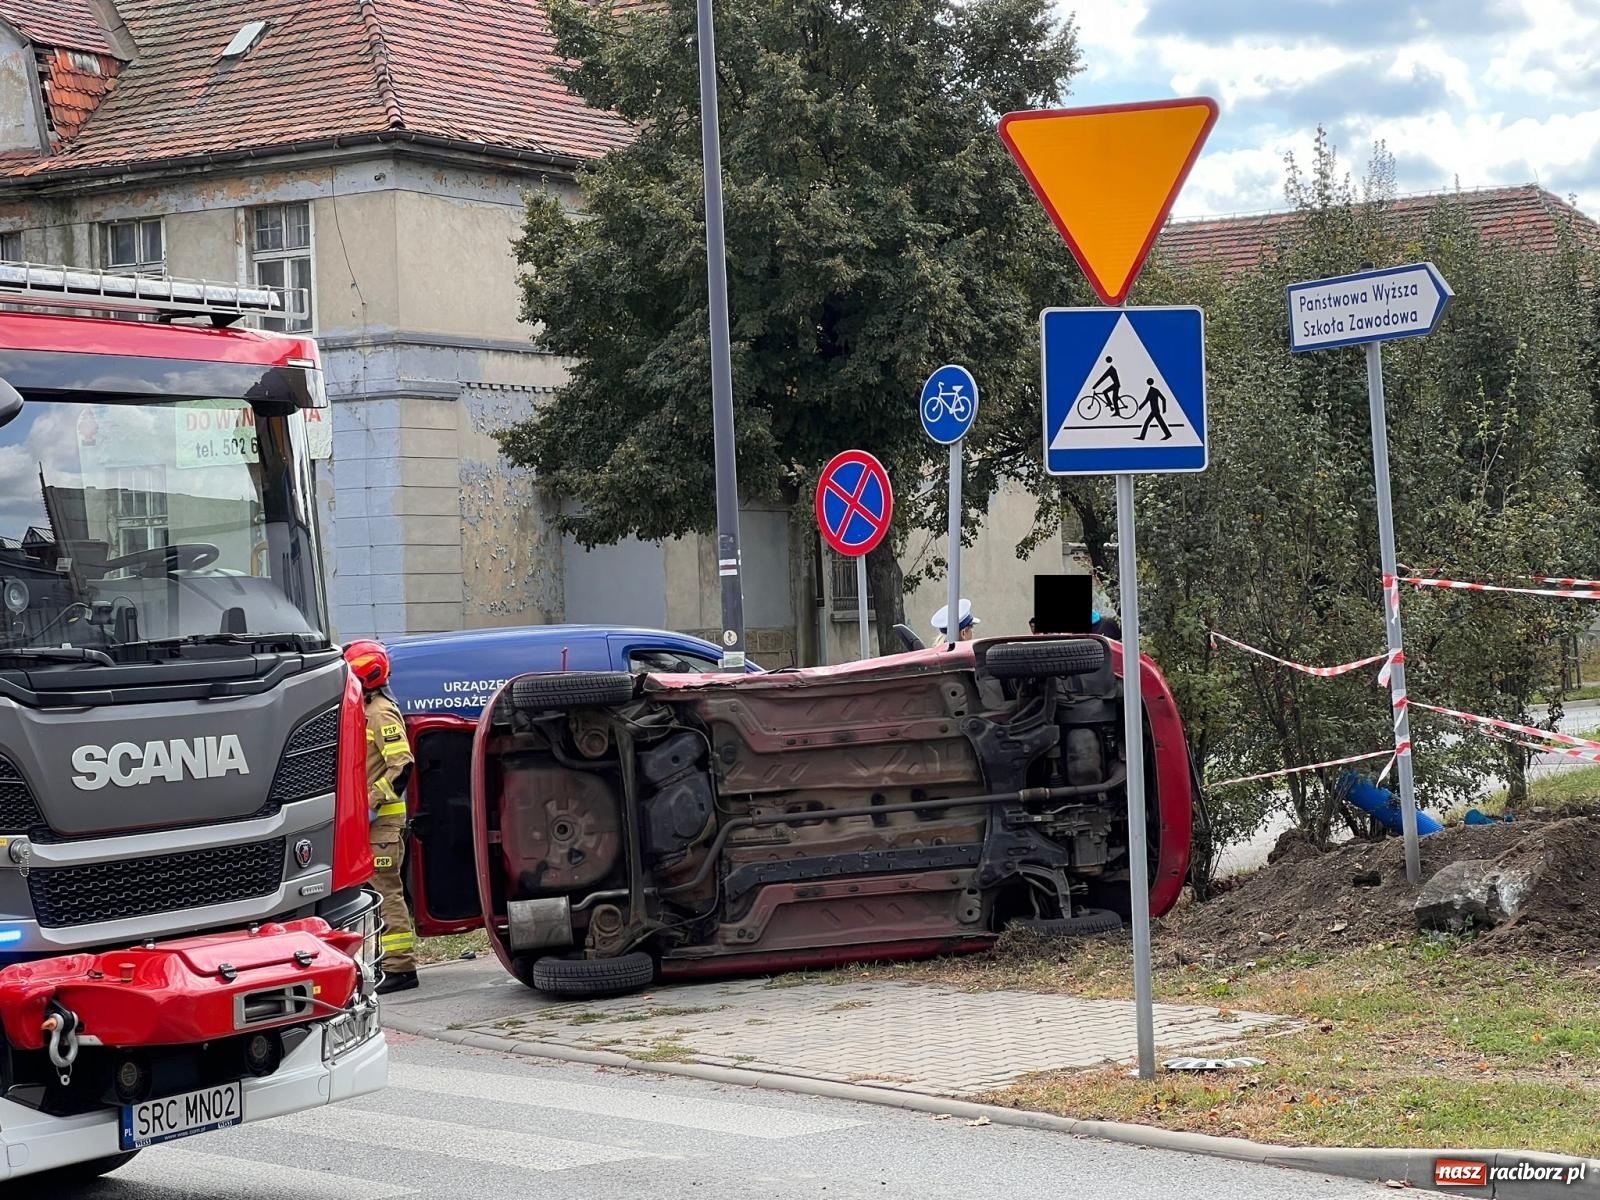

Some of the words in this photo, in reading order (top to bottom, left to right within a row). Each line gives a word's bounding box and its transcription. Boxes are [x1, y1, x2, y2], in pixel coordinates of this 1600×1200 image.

[1300, 291, 1367, 312] Państwowa
[1372, 282, 1418, 305] Wyższa
[1303, 316, 1344, 337] Szkoła
[1349, 309, 1418, 331] Zawodowa
[186, 412, 210, 431] DO
[196, 440, 218, 458] tel.
[223, 437, 246, 455] 502
[443, 679, 509, 693] URZĄDZE
[407, 700, 411, 710] I
[414, 694, 490, 710] WYPOSAŻE
[384, 726, 397, 734] PSP
[71, 734, 250, 791] SCANIA
[376, 858, 390, 866] PSP
[138, 1100, 177, 1135] SRC
[124, 1128, 132, 1137] PL
